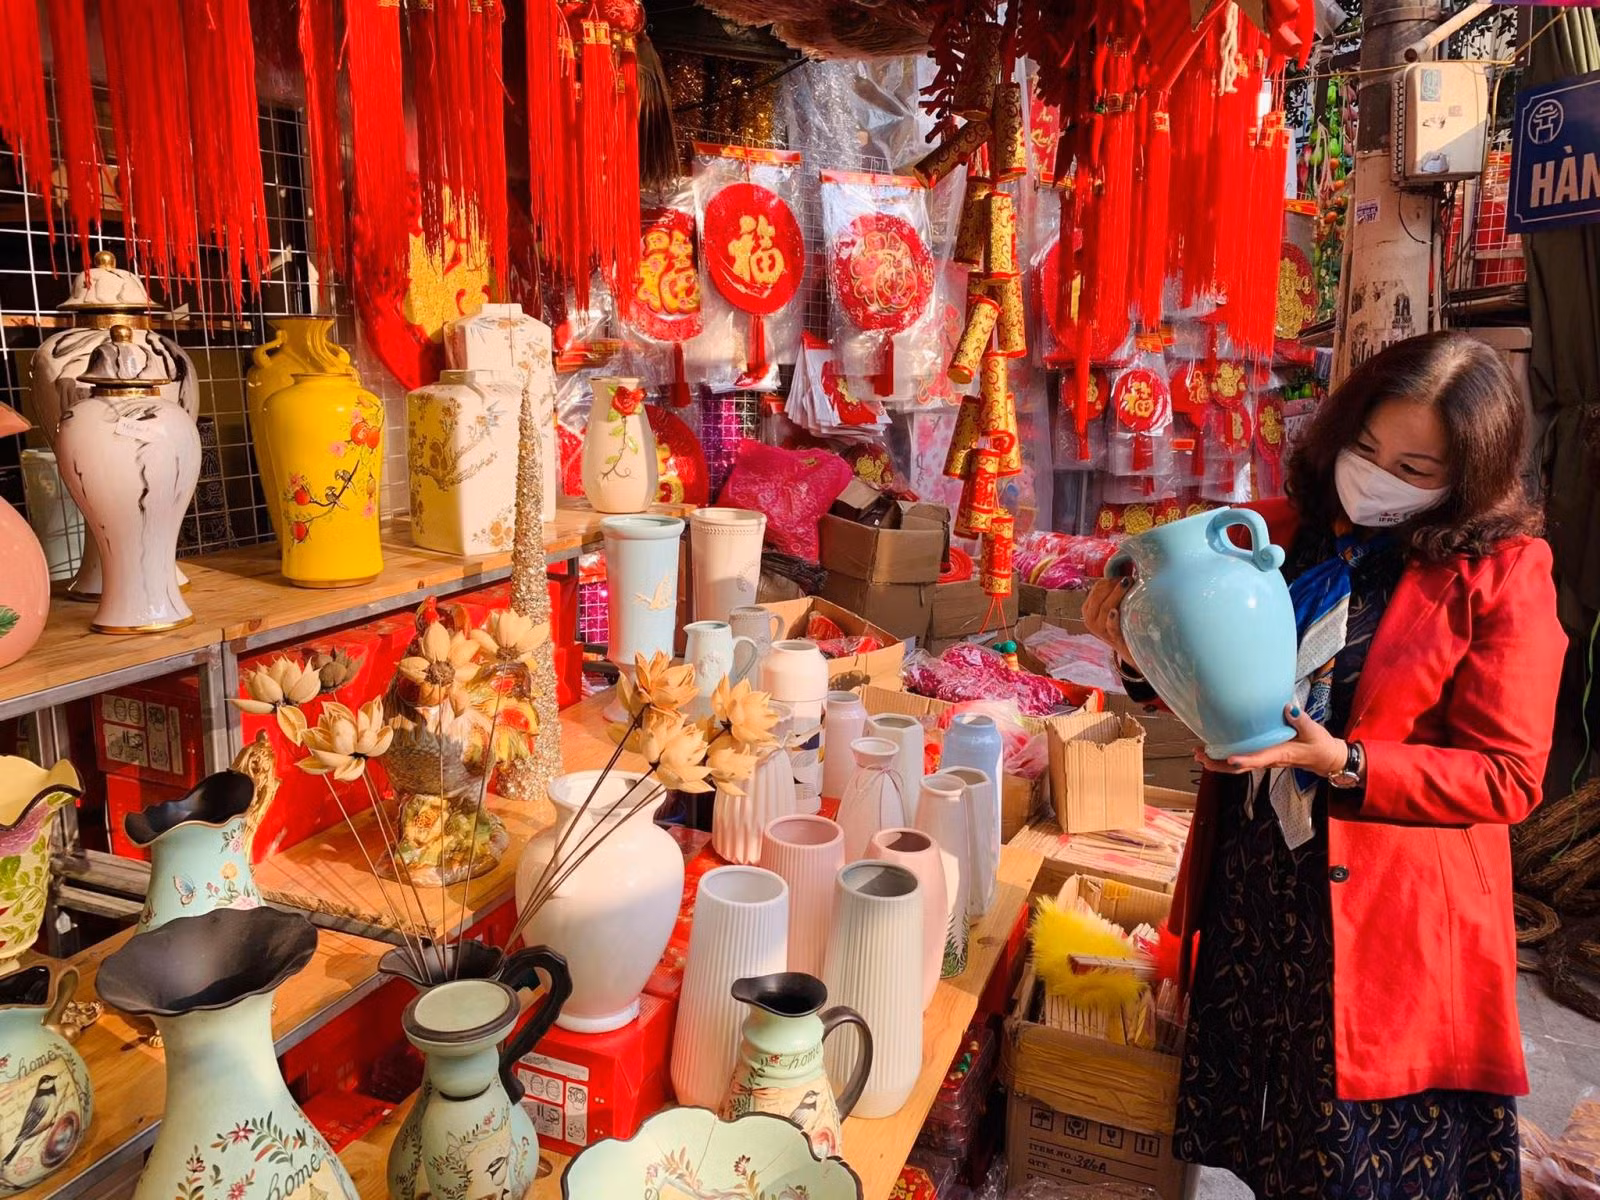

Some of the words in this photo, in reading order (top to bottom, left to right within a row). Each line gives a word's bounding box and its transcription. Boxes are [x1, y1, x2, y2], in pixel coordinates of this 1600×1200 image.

[1530, 145, 1600, 208] HÀN
[727, 214, 785, 284] 福
[9, 1049, 58, 1081] home
[1029, 1143, 1054, 1156] ITEM
[265, 1152, 321, 1200] home
